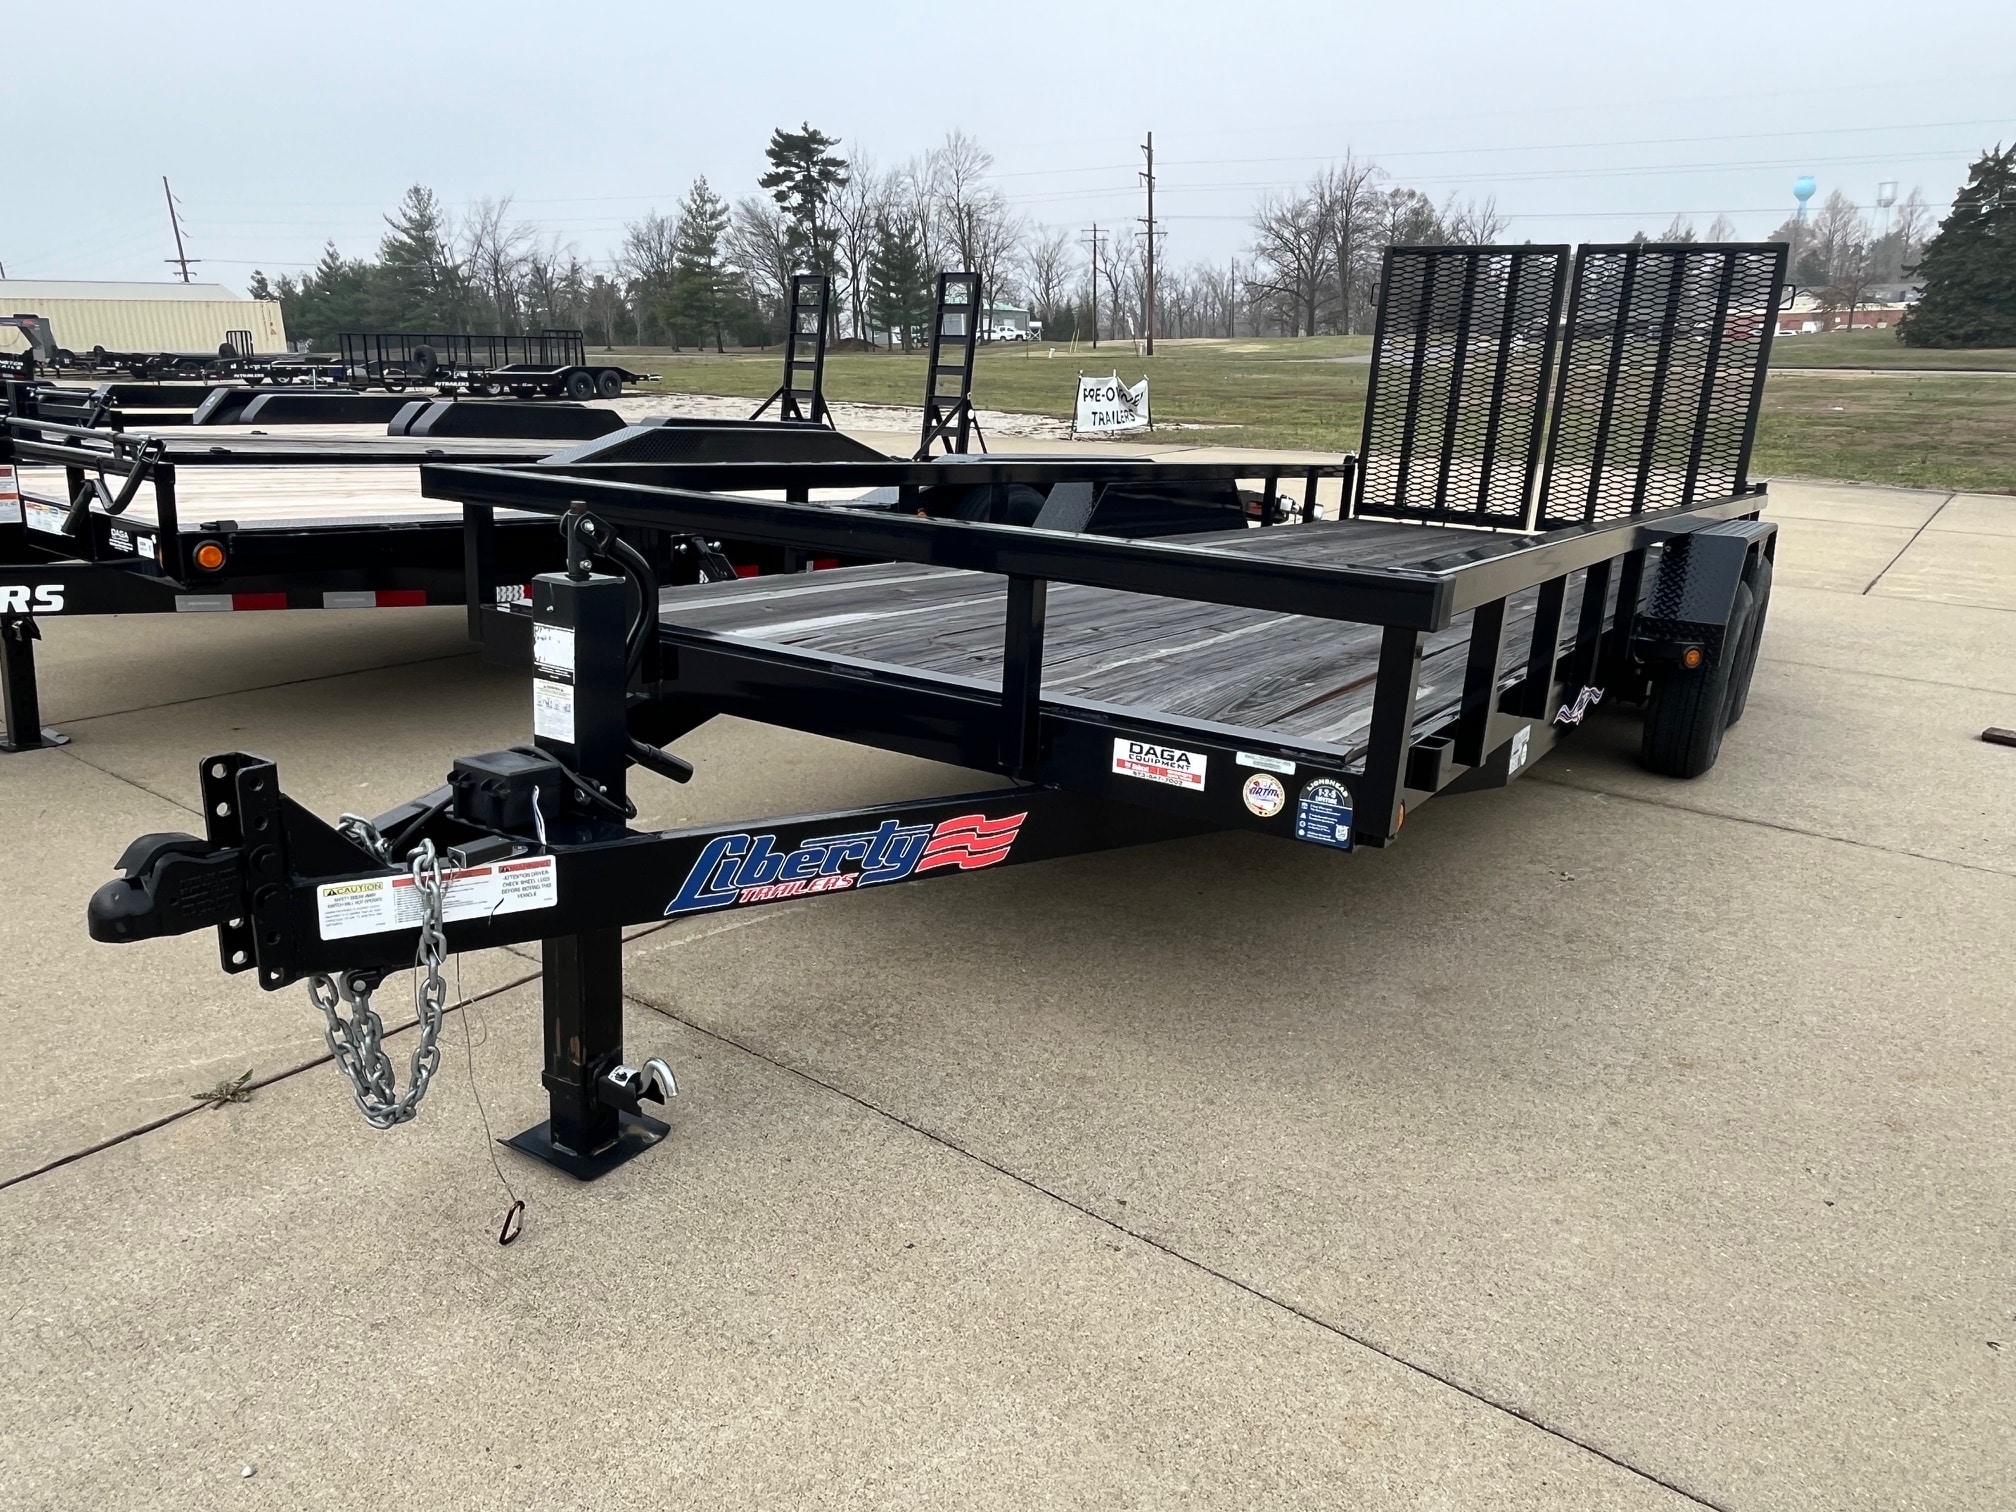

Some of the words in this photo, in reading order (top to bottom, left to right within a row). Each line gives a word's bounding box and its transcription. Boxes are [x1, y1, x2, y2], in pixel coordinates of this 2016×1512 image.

[1091, 408, 1136, 426] TRAILERS
[1128, 753, 1191, 771] EQUIPMENT
[1129, 742, 1191, 765] DAGA
[503, 873, 530, 881] ATTENTION
[664, 820, 934, 916] Liberty
[336, 882, 382, 895] CAUTION
[502, 880, 519, 888] CHECK
[739, 872, 860, 903] TRAILERS
